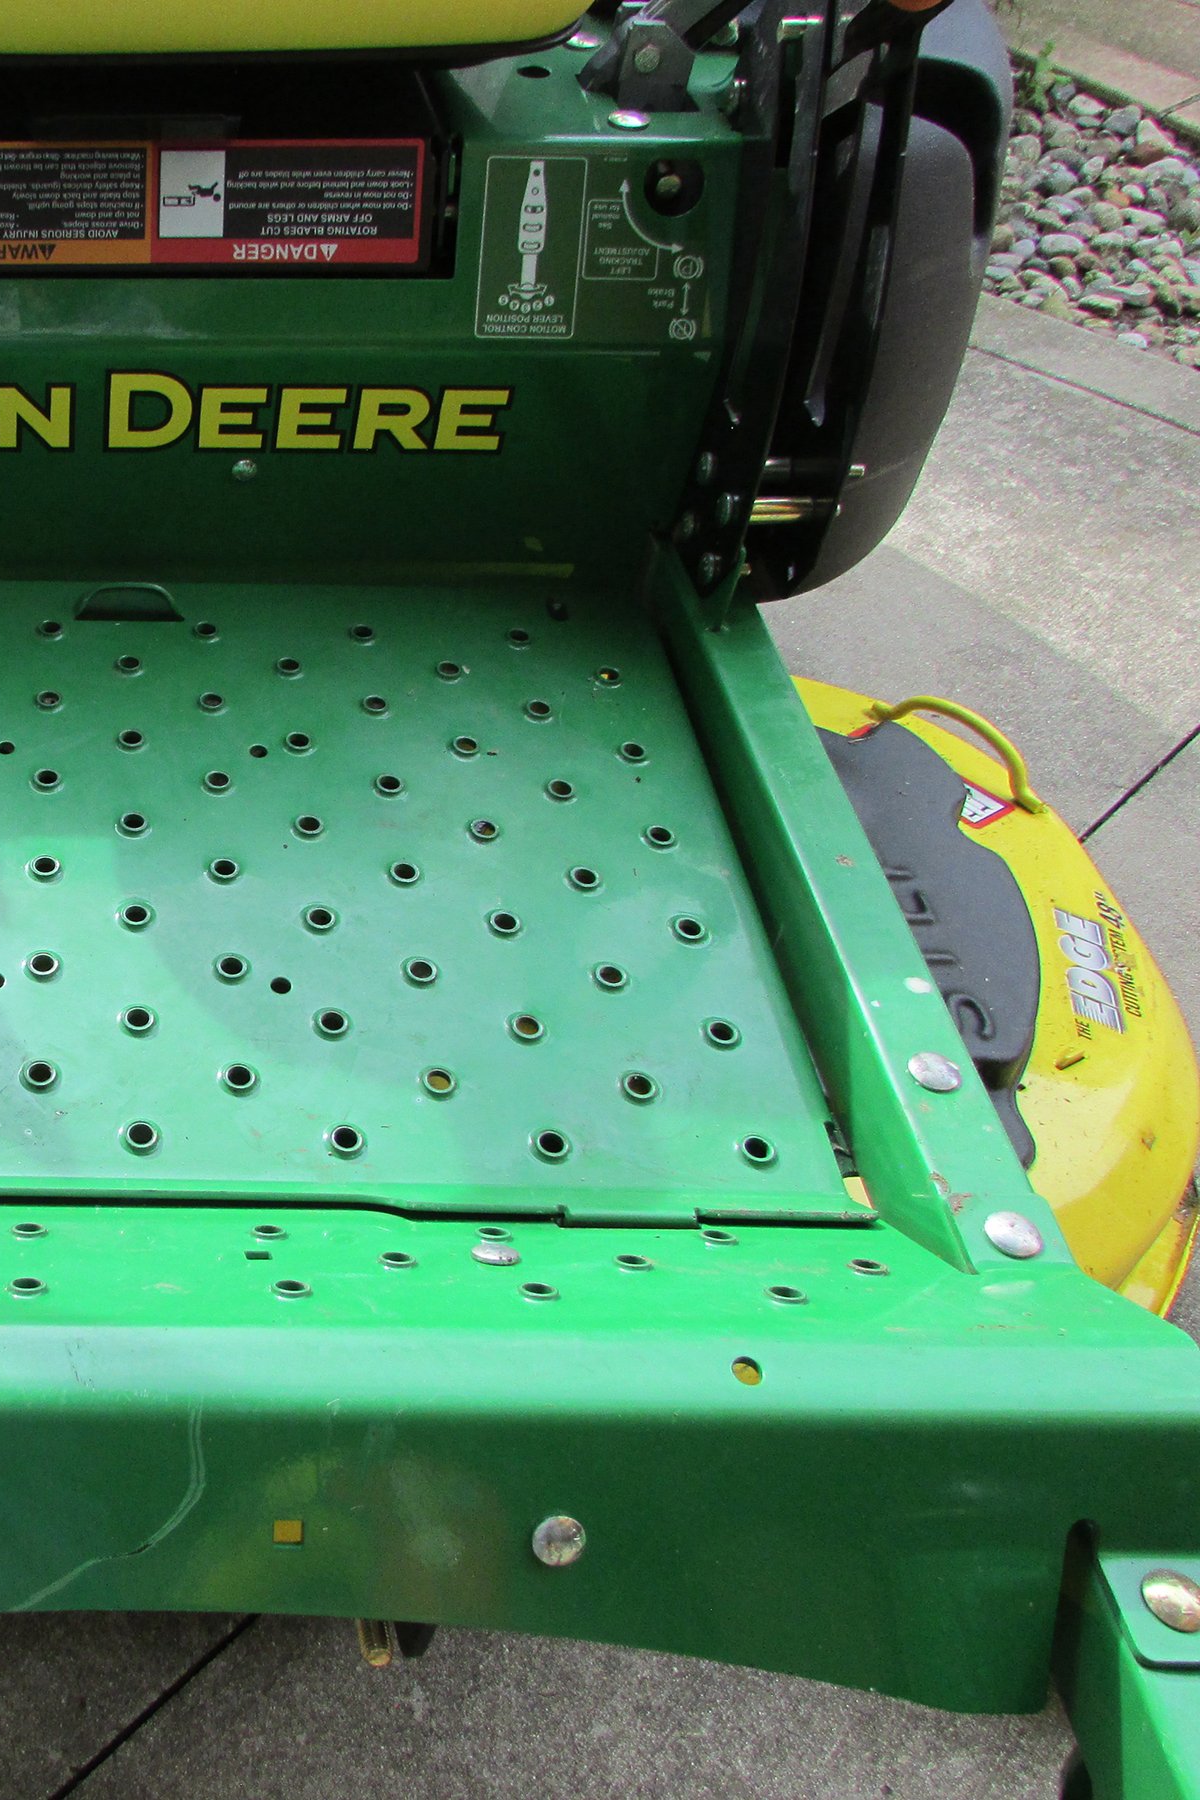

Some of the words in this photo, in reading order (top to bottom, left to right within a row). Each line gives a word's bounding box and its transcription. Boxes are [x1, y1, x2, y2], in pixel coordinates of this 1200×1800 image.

[267, 213, 294, 222] LEGS
[297, 213, 318, 222] AND
[321, 213, 350, 222] ARMS
[352, 213, 373, 222] OFF
[3, 229, 38, 239] INJURY
[41, 229, 85, 239] SERIOUS
[88, 229, 118, 239] AVOID
[260, 226, 280, 236] CUT
[283, 226, 324, 236] BLADES
[327, 226, 377, 236] ROTATING
[232, 243, 317, 260] DANGER
[593, 247, 650, 255] ADJUSTMENT
[599, 257, 642, 265] TRACKING
[610, 266, 632, 274] LEFT
[648, 288, 675, 297] Brake
[652, 300, 674, 309] Park
[486, 314, 530, 322] POSITION
[532, 314, 563, 322] LEVER
[482, 324, 527, 334] CONTROL
[530, 324, 566, 334] MOTION
[104, 369, 513, 453] DEERE
[1053, 907, 1125, 1035] EDGE
[1074, 1018, 1092, 1040] THE
